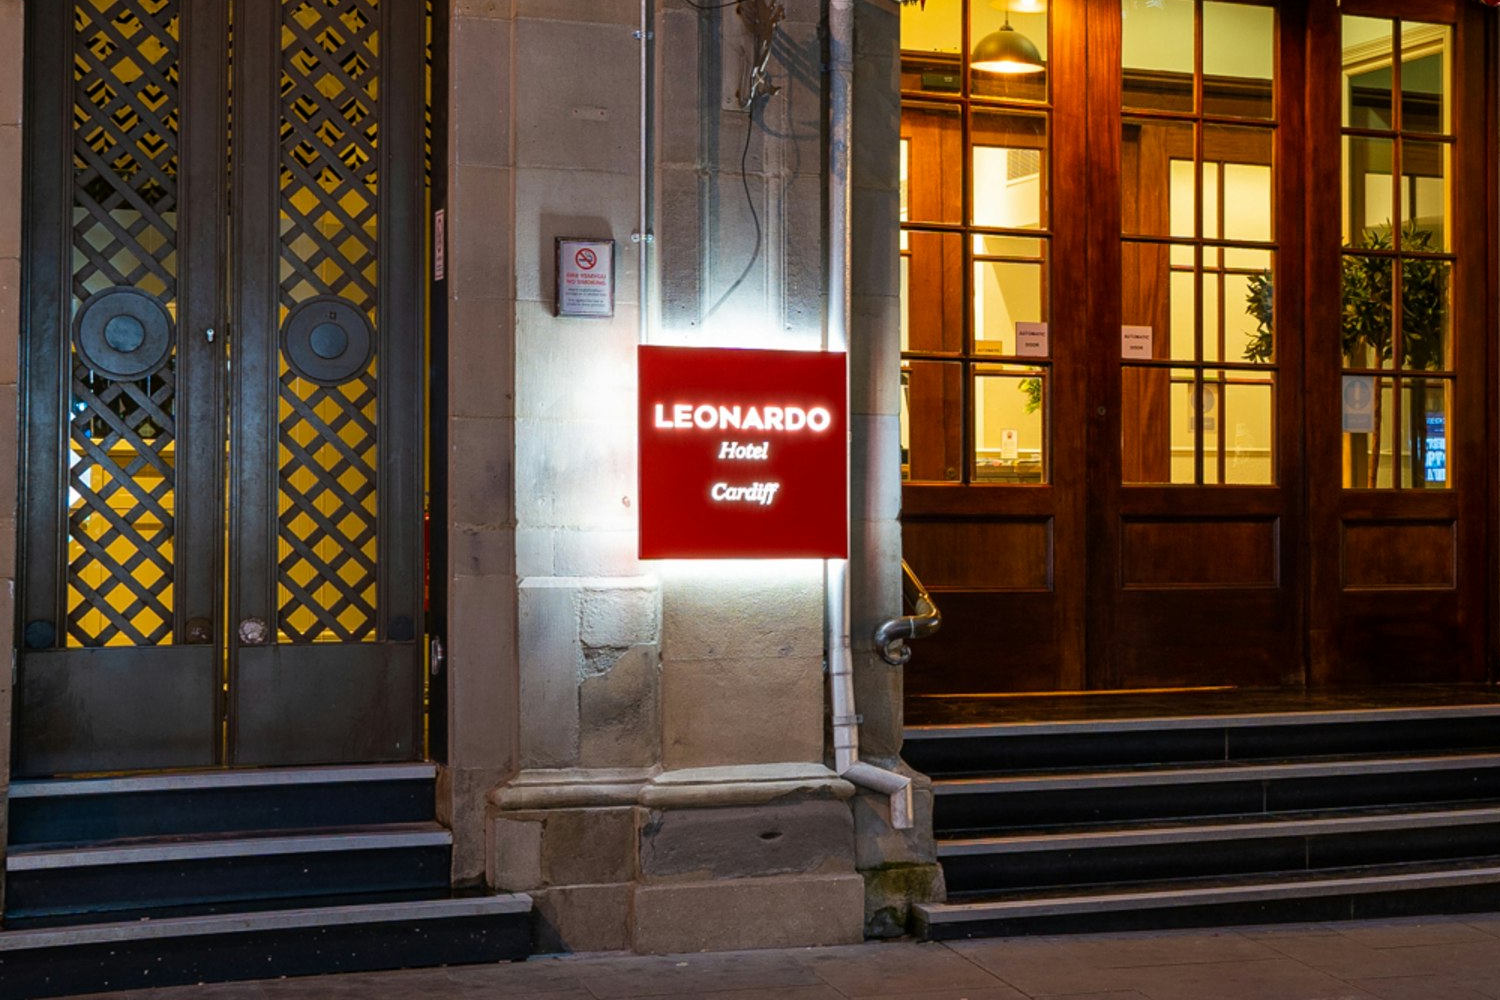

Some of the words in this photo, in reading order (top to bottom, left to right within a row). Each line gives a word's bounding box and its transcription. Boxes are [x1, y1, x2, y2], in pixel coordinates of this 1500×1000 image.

[655, 404, 831, 432] LEONARDO
[718, 441, 769, 460] Hotel
[711, 482, 780, 505] Cardiff
